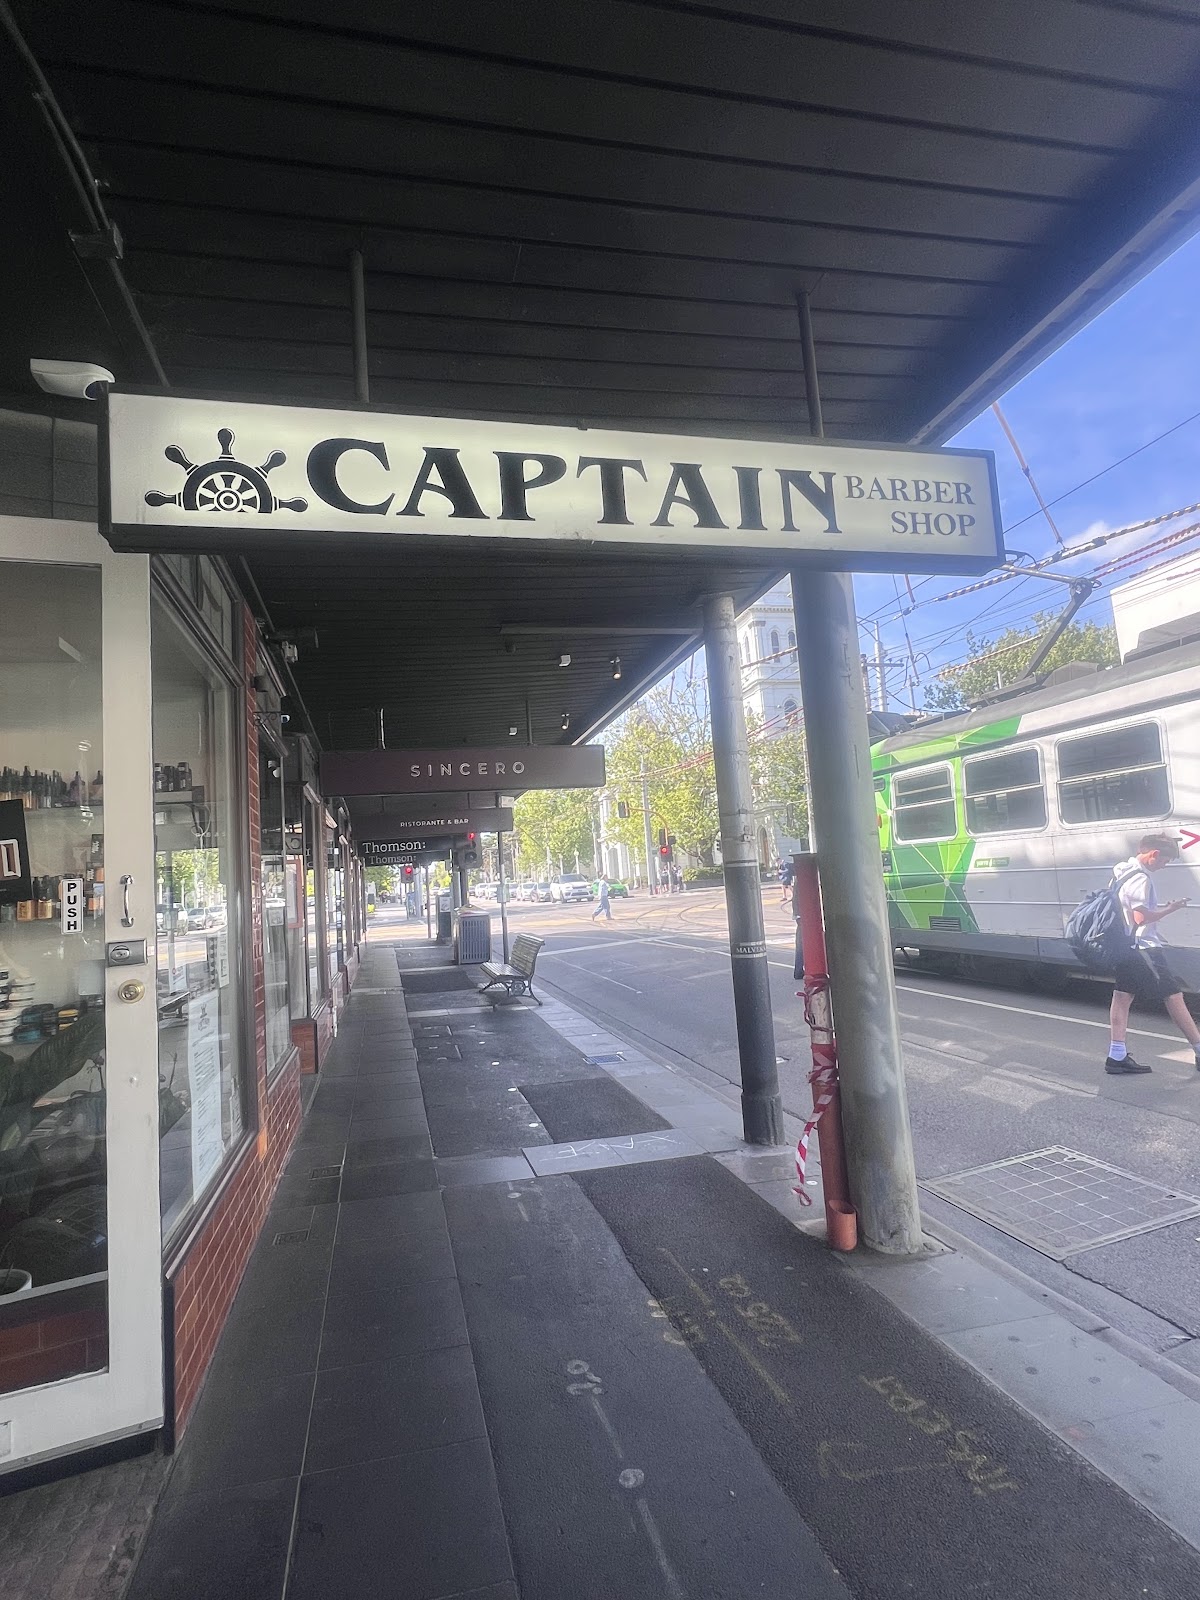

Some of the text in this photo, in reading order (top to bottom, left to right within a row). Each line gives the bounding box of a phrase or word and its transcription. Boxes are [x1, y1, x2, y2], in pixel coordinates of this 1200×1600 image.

[306, 437, 843, 533] CAPTAIN
[843, 475, 976, 505] BARBER
[891, 511, 976, 537] SHOP
[410, 761, 525, 777] SINCERO
[400, 819, 445, 827] RISTORANTE
[362, 841, 426, 854] Thomson:
[67, 882, 78, 931] PUSH
